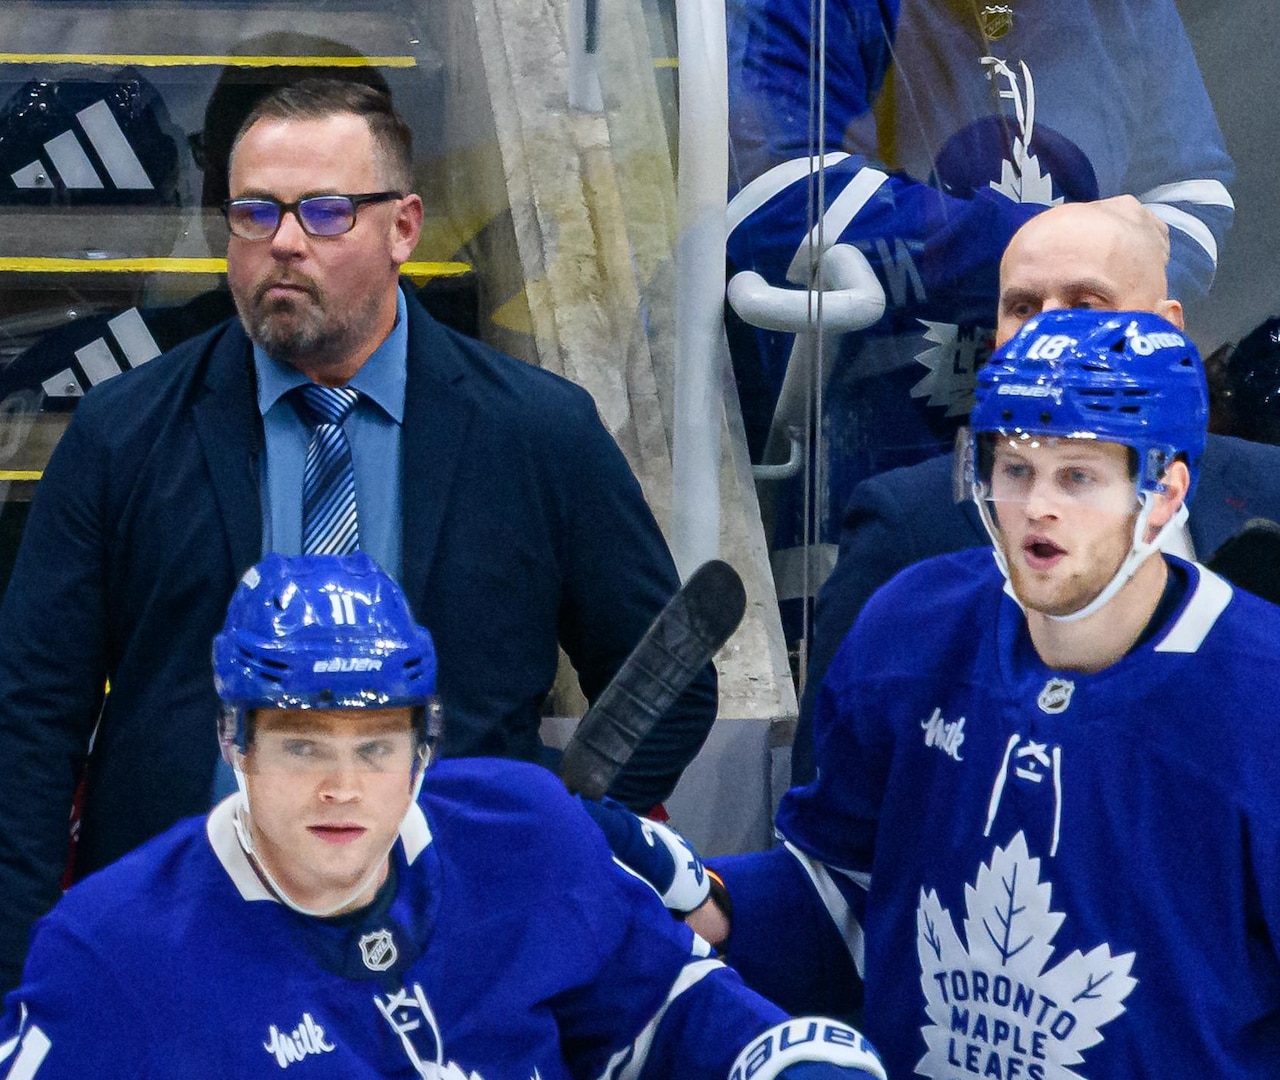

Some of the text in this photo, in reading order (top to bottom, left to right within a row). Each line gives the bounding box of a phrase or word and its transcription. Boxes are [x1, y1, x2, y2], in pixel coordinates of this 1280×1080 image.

[1026, 335, 1070, 360] 18
[328, 594, 356, 625] 11
[313, 658, 383, 673] BAUER
[933, 970, 1079, 1042] TORONTO
[264, 1012, 335, 1068] Milk
[951, 1004, 1046, 1061] MAPLE
